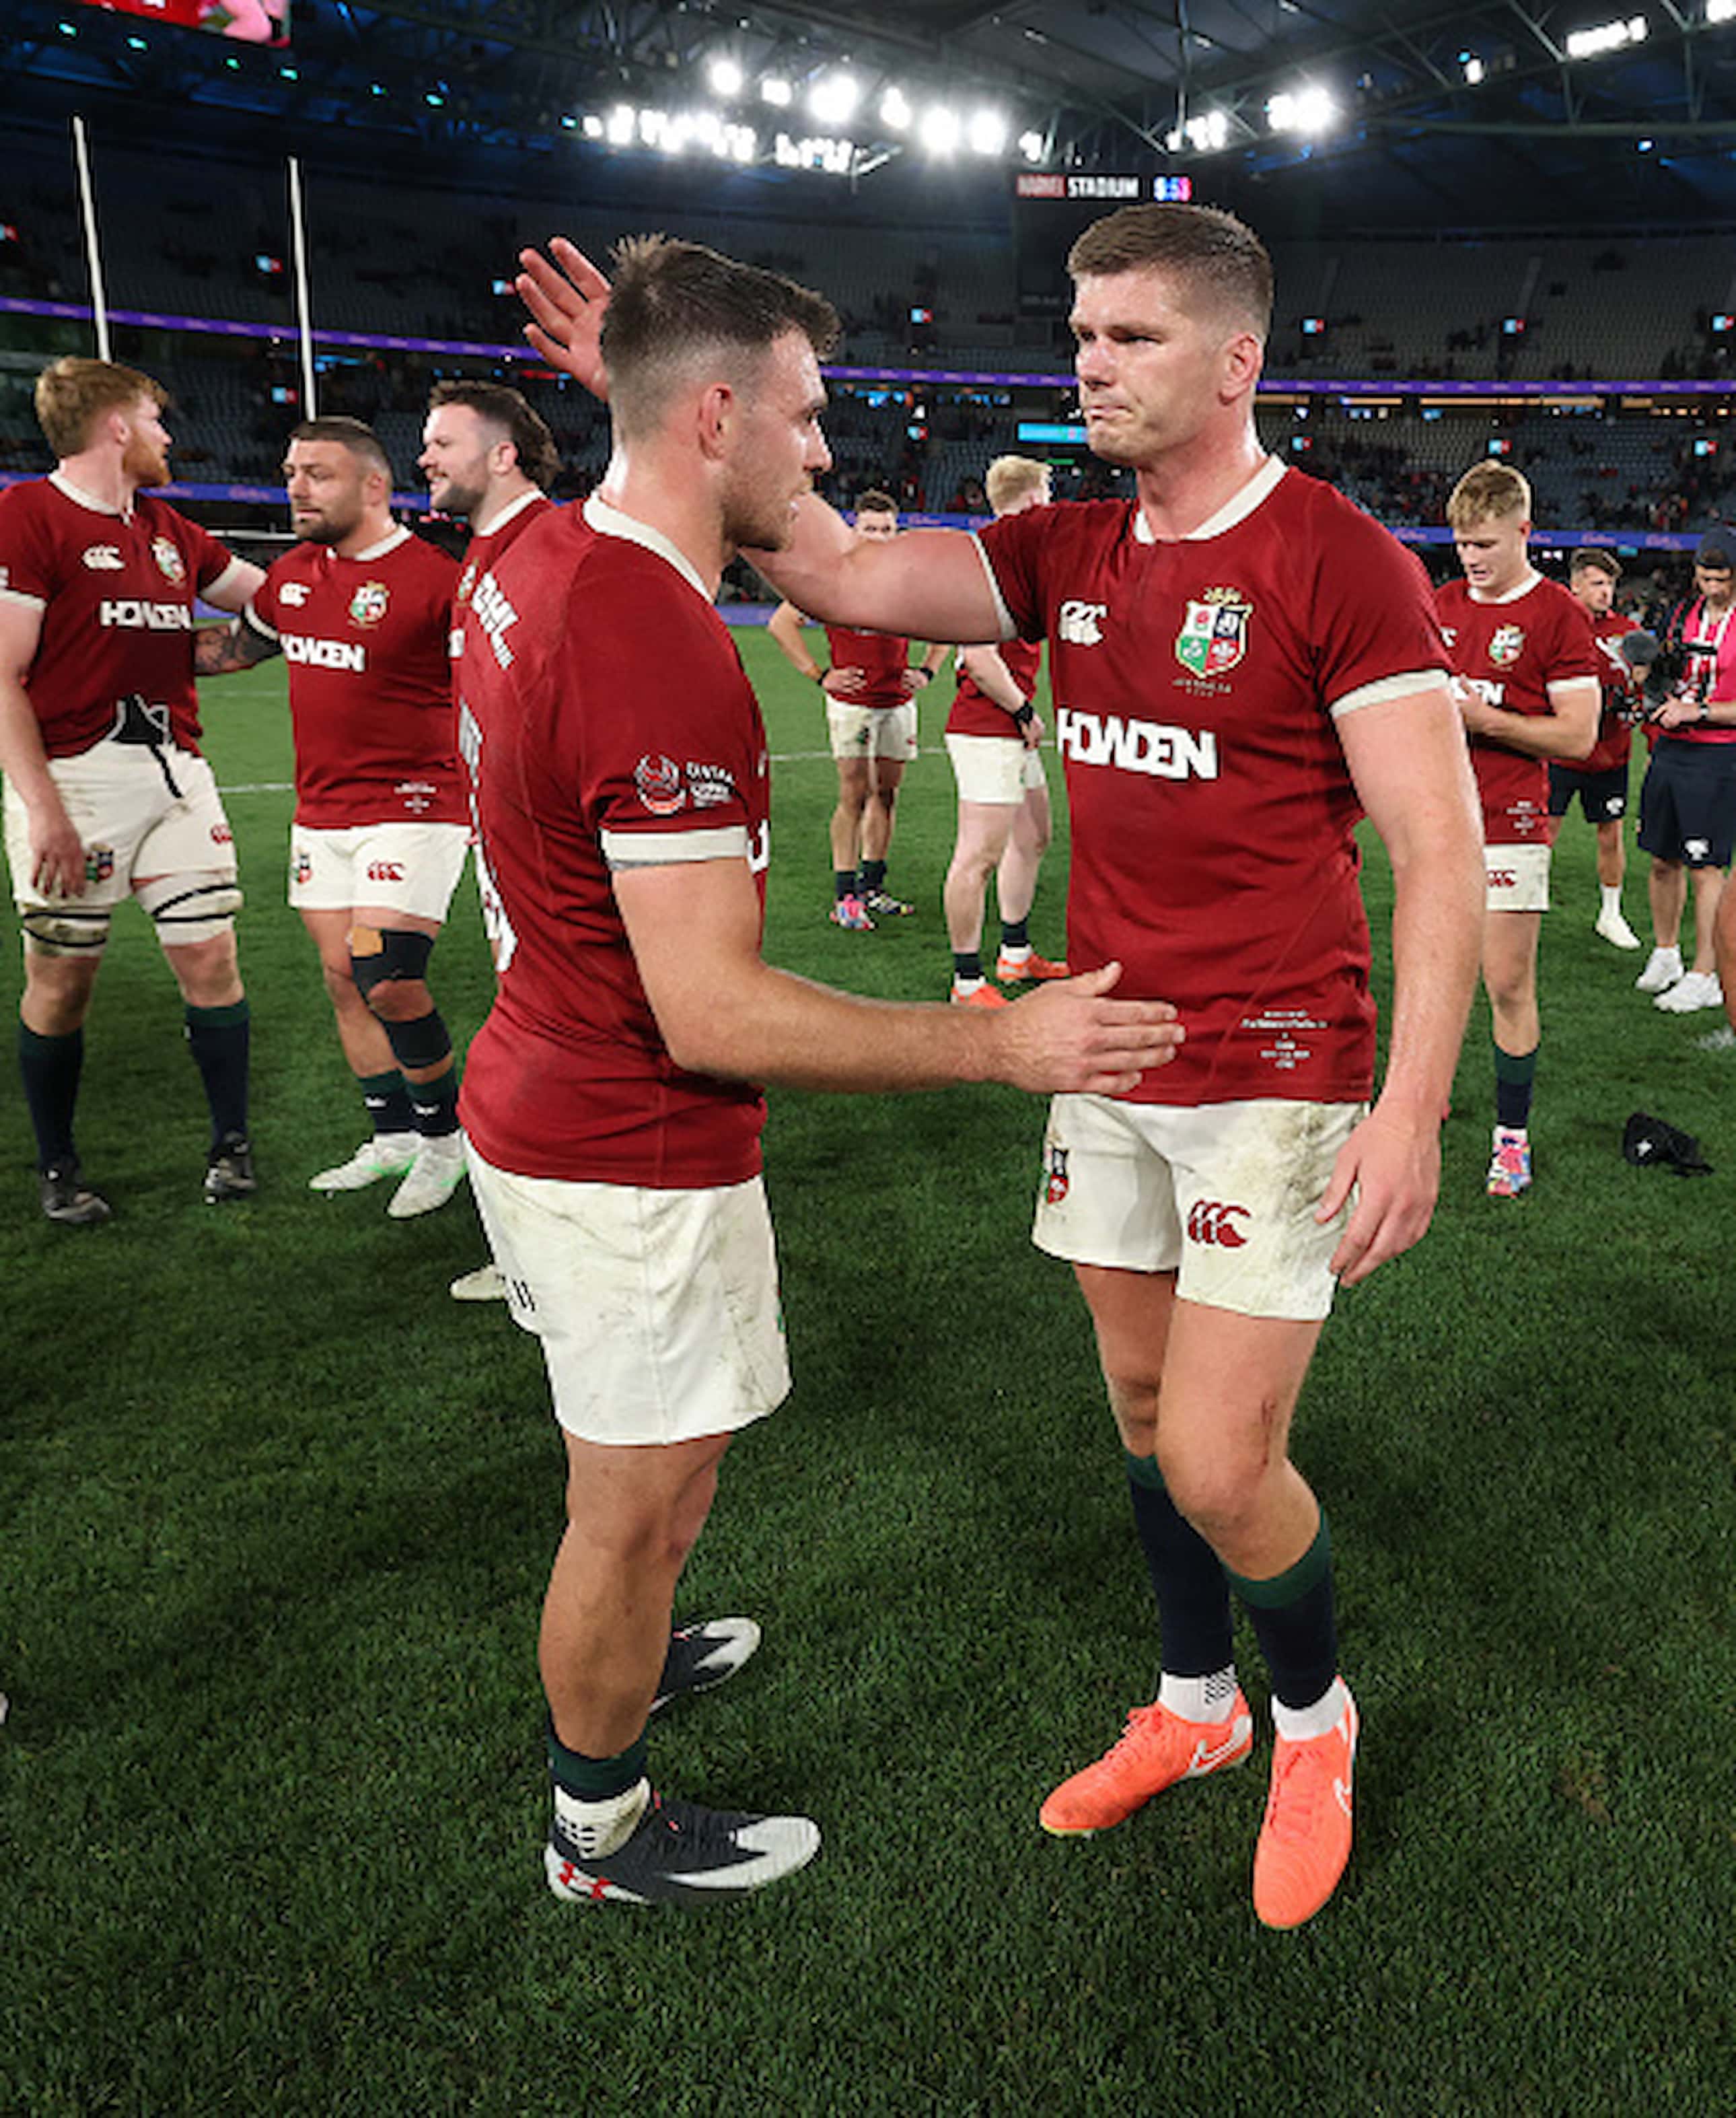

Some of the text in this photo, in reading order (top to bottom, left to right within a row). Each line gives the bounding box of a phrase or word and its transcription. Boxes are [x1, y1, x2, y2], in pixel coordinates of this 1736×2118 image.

[1067, 176, 1139, 198] STADIUM
[100, 600, 192, 630] HOWDEN
[1057, 708, 1217, 779] HOWDEN
